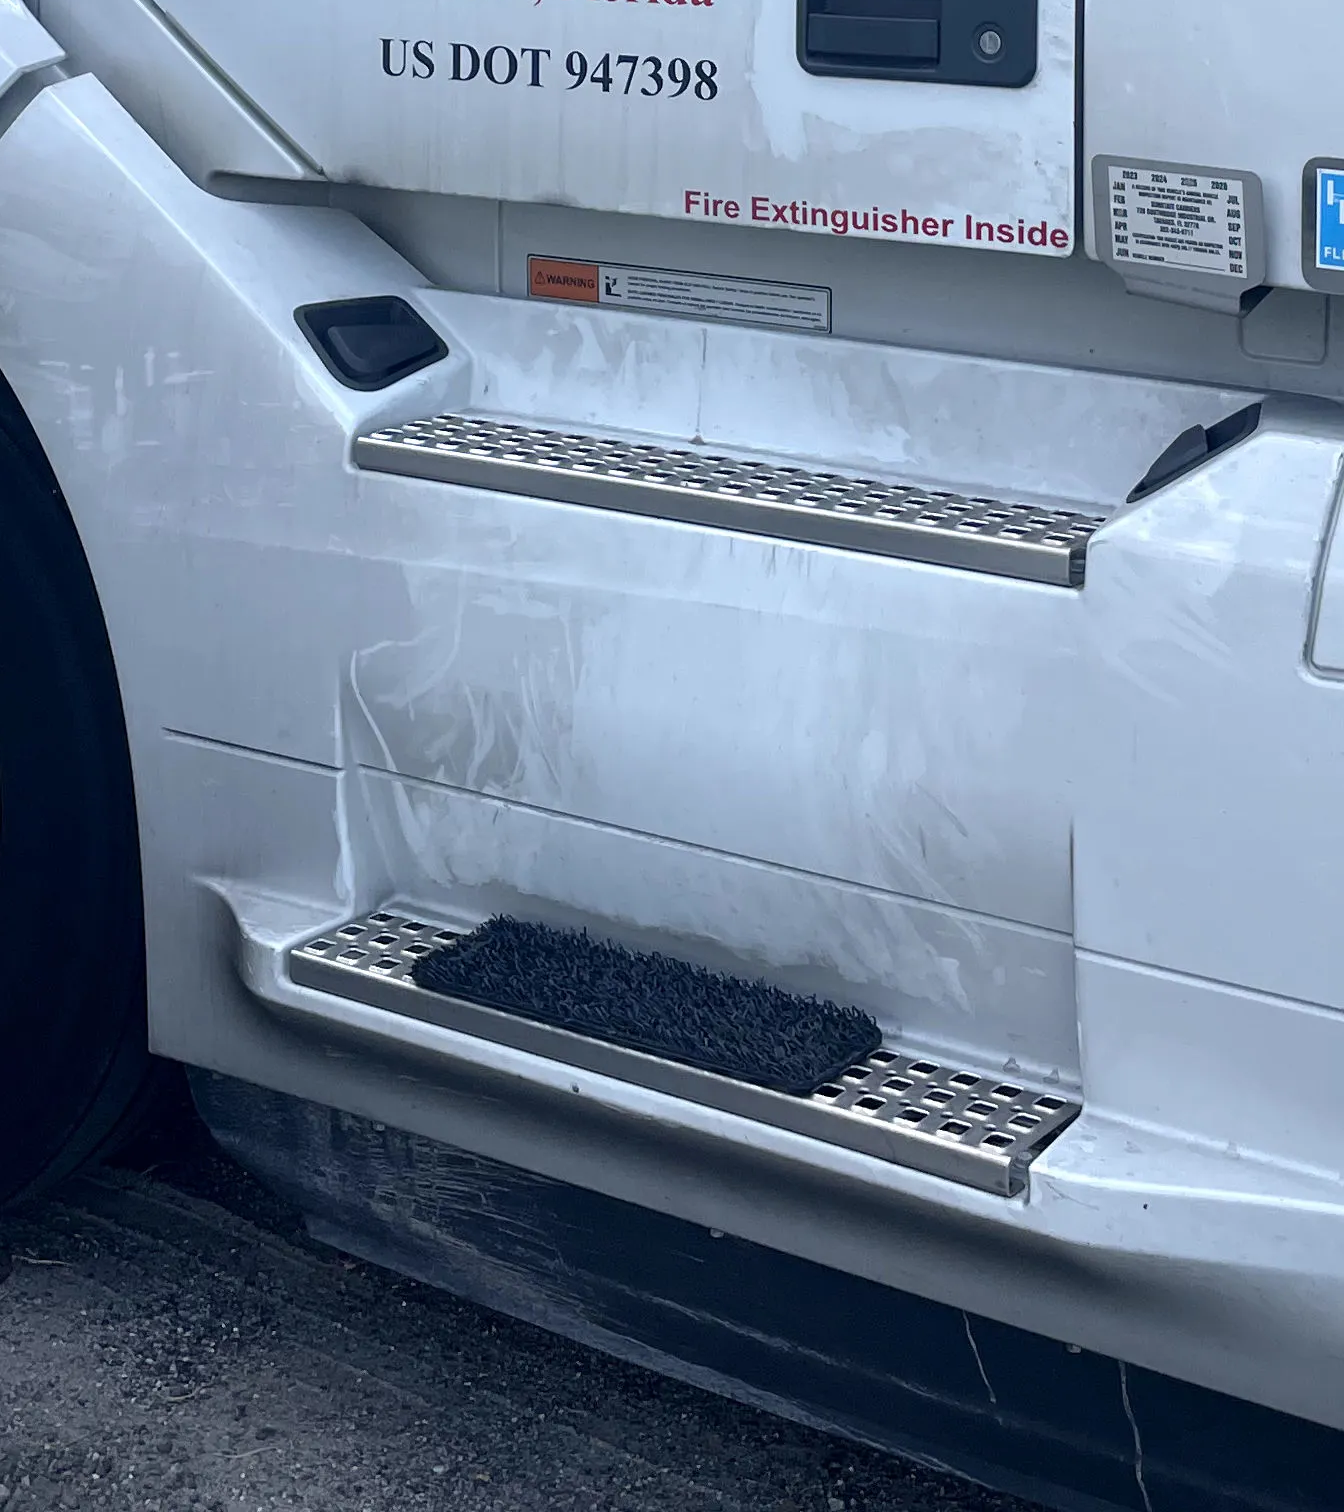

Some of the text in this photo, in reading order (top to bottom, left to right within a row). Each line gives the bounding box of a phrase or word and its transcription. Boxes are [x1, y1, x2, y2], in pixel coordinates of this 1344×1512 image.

[380, 38, 718, 101] US DOT 947398
[684, 190, 1070, 249] Fire Extinguisher Inside
[1324, 247, 1340, 259] FL
[546, 274, 595, 289] WARNING
